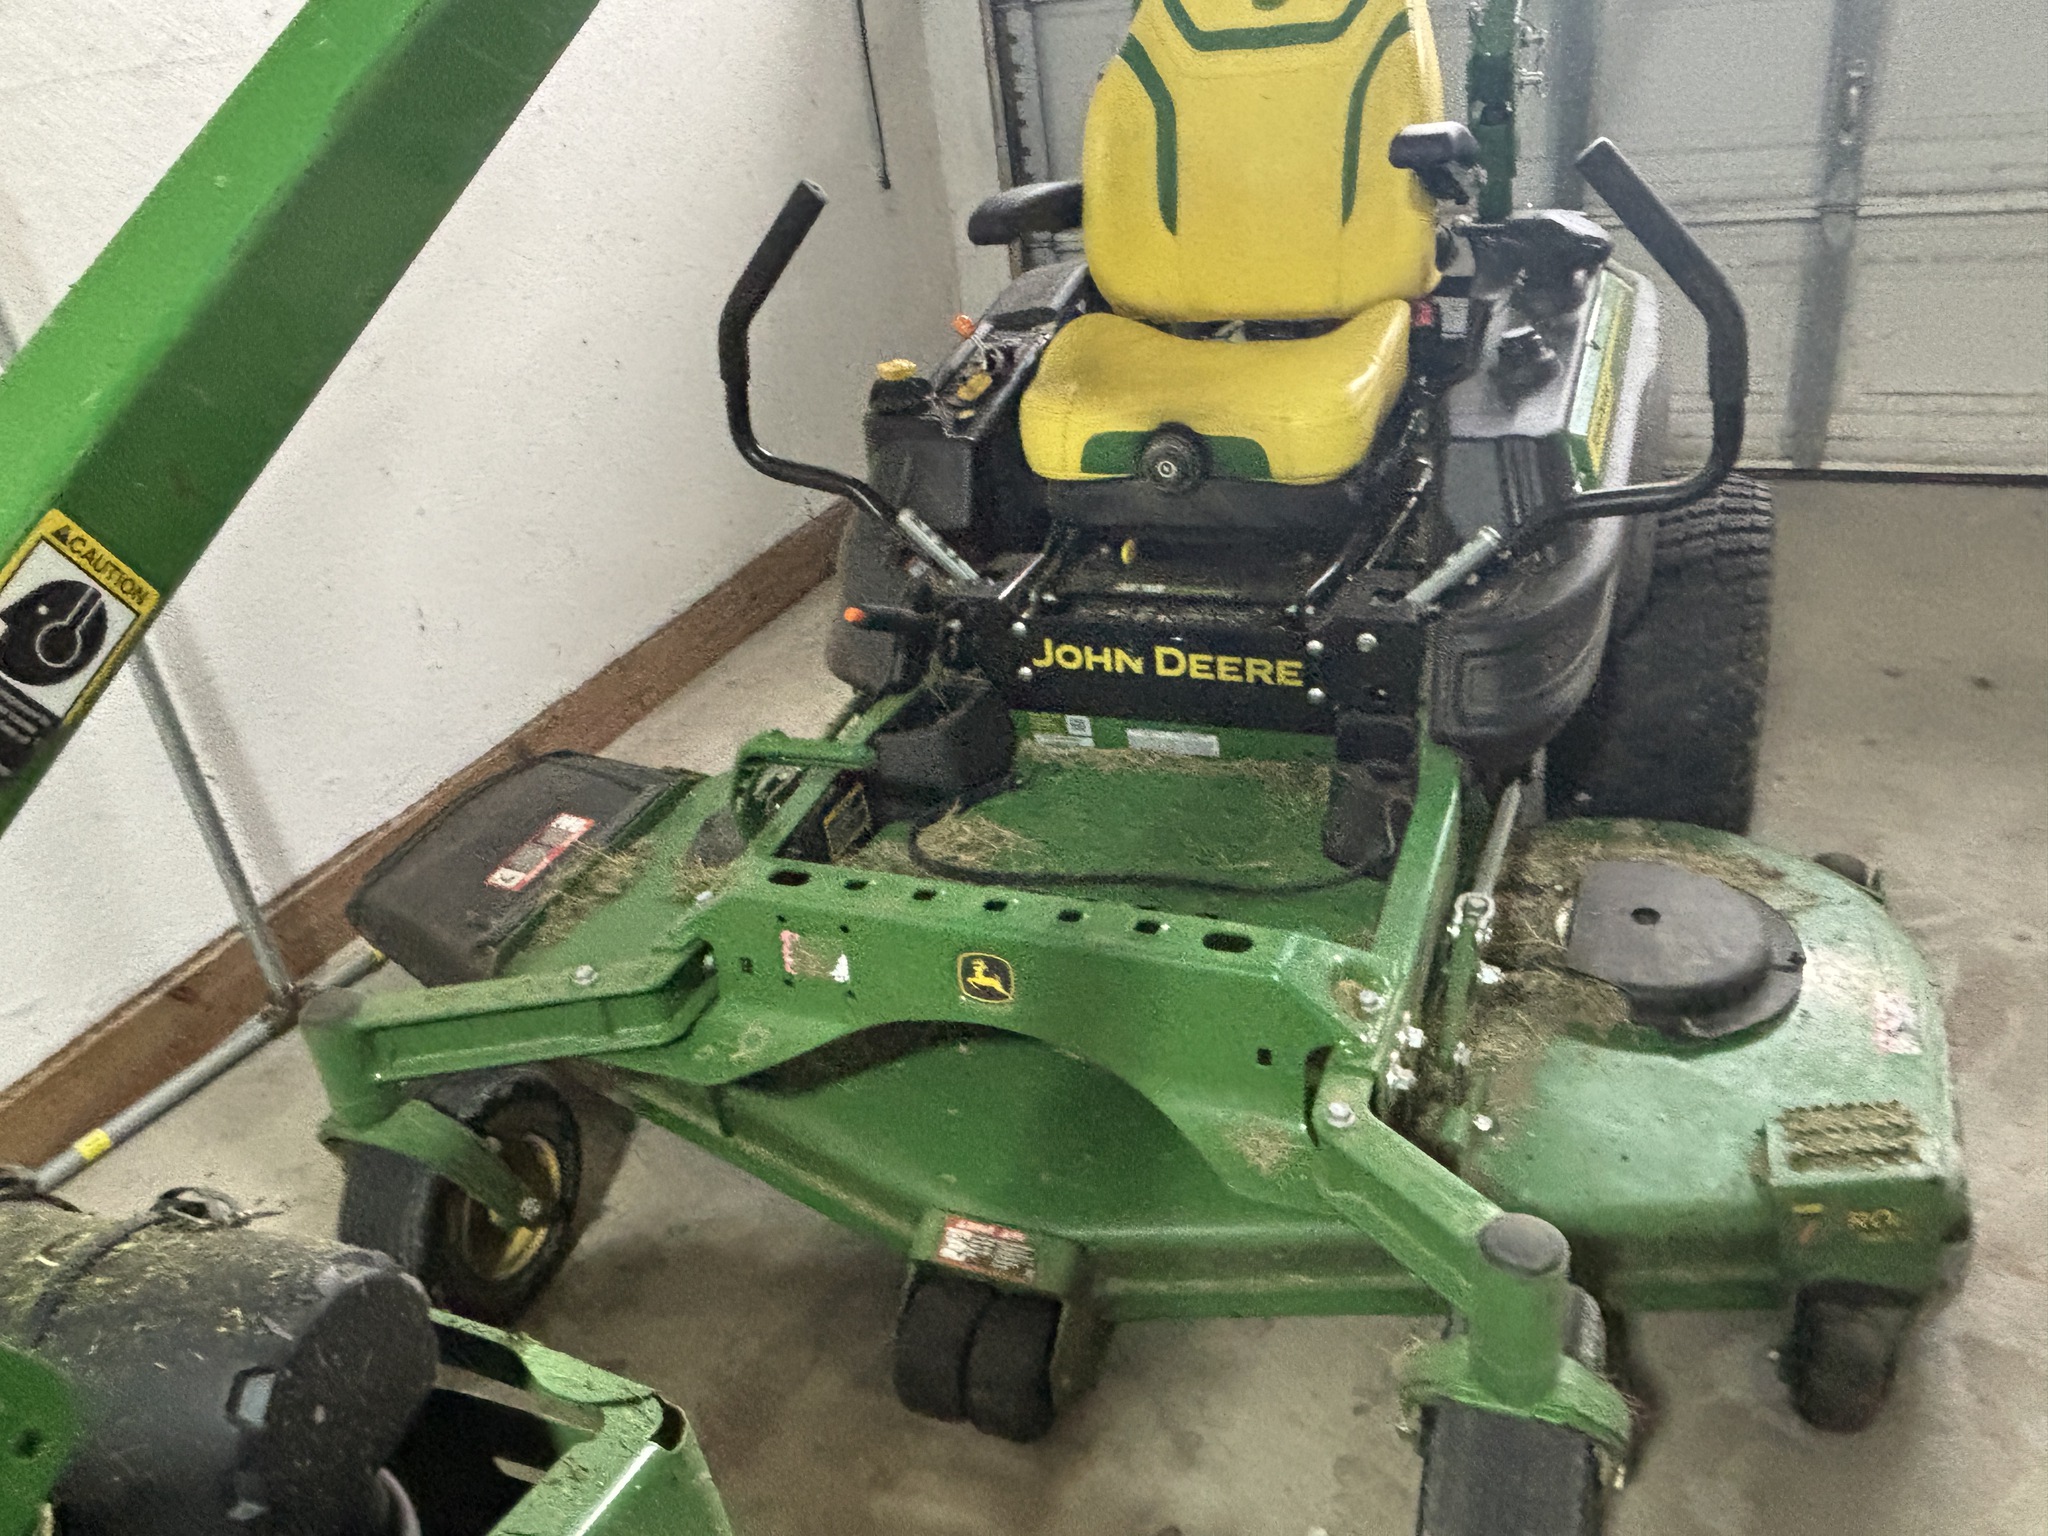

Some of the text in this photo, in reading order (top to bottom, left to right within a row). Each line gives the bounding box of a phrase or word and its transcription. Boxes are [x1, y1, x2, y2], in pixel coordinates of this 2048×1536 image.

[68, 537, 149, 604] CAUTION
[1032, 638, 1304, 687] JOHN DEERE
